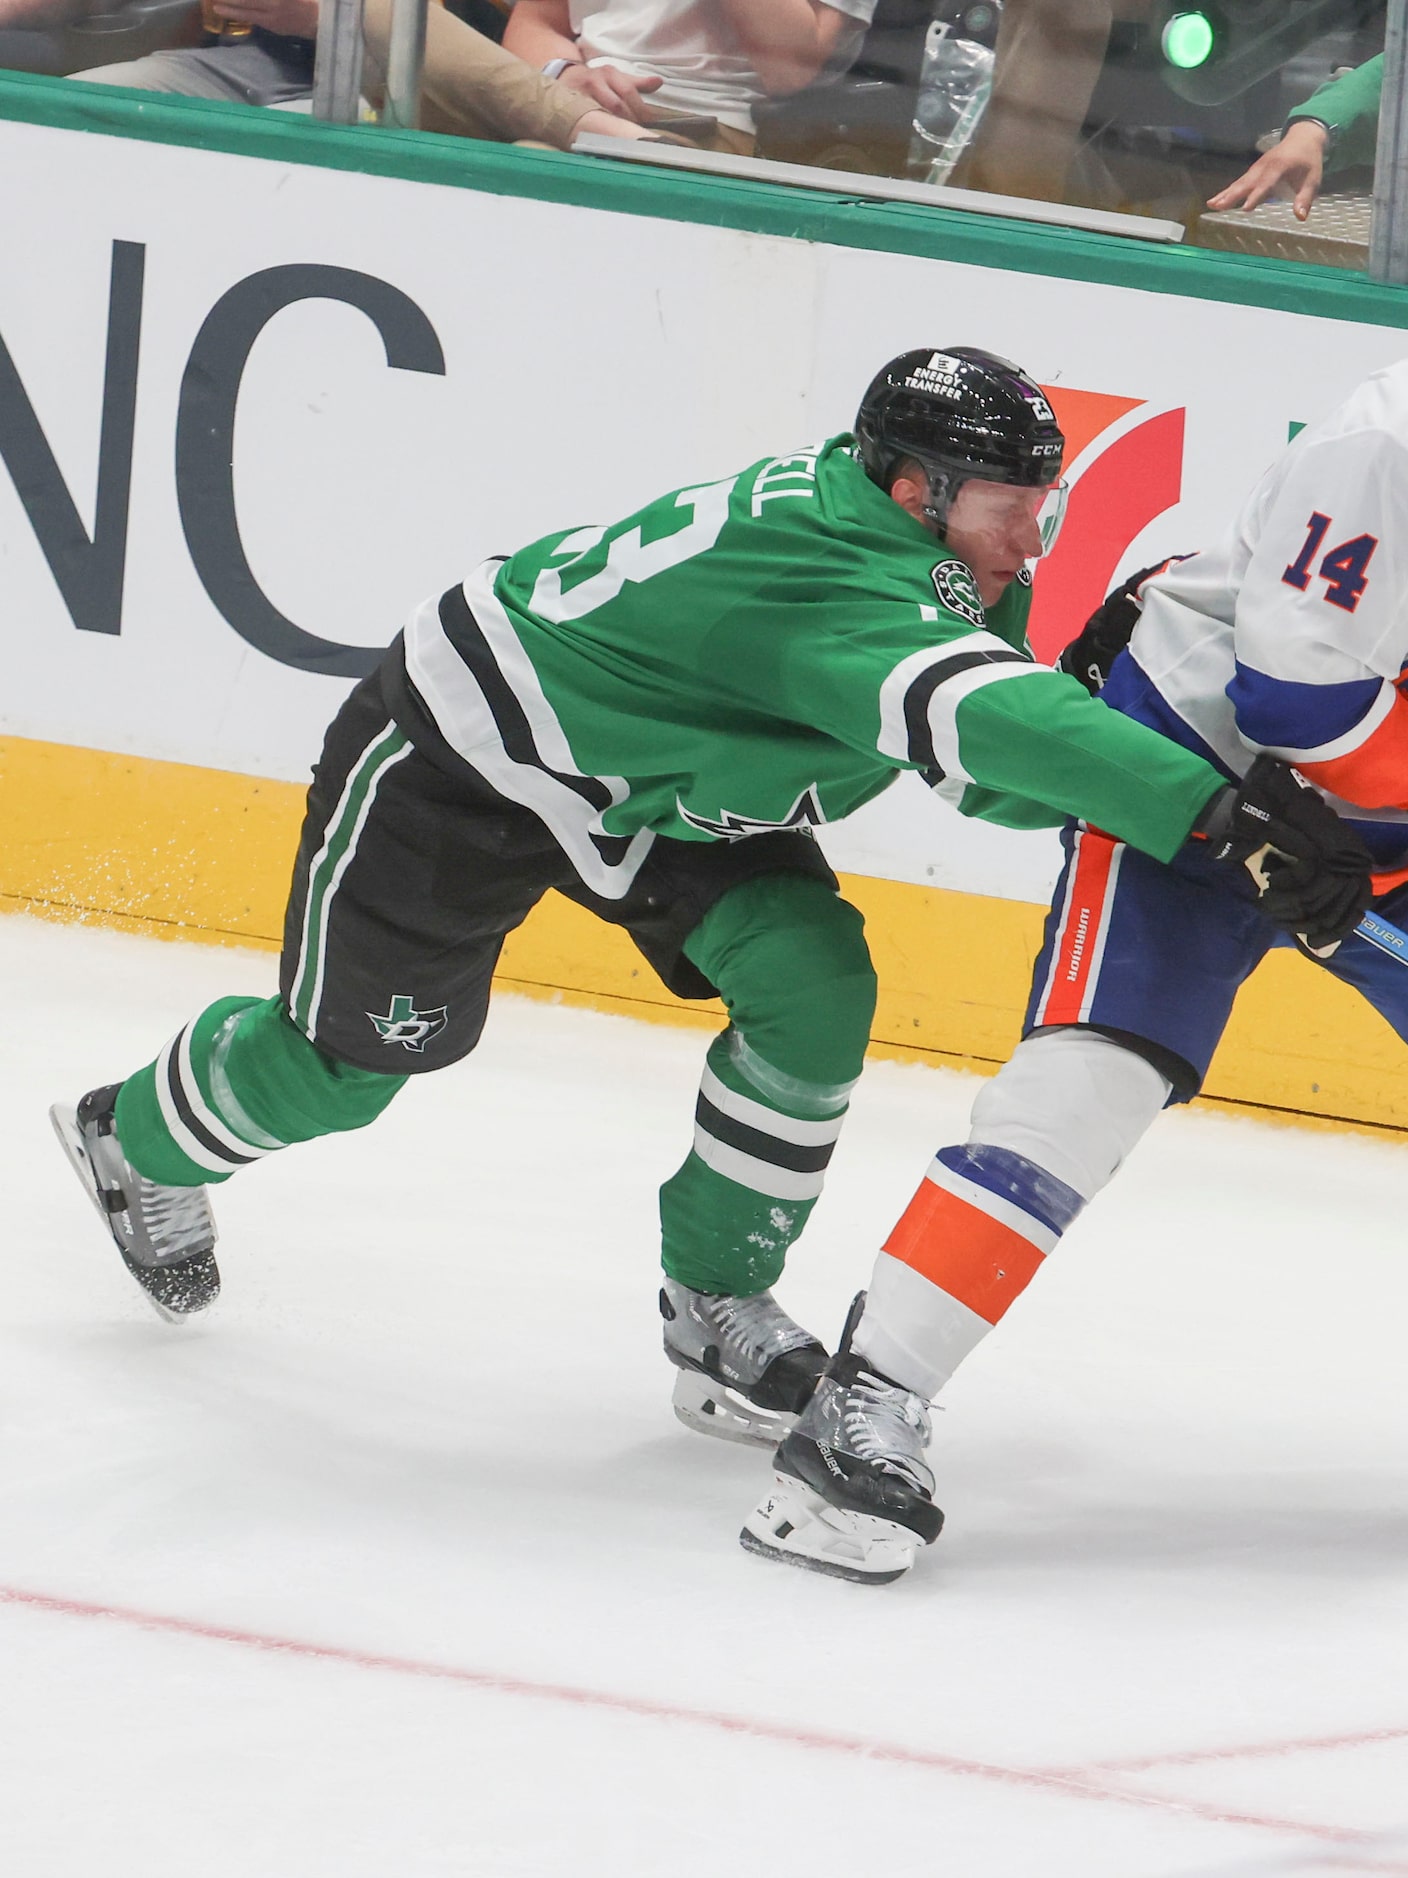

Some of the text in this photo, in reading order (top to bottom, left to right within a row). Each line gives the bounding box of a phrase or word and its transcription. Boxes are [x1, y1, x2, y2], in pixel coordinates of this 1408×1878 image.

[904, 376, 962, 401] TRANSFER
[913, 366, 963, 388] ENERGY
[1031, 443, 1062, 456] CCM
[1281, 510, 1379, 614] 14
[1241, 801, 1271, 822] LINDELL
[1066, 907, 1090, 982] WARRIOR
